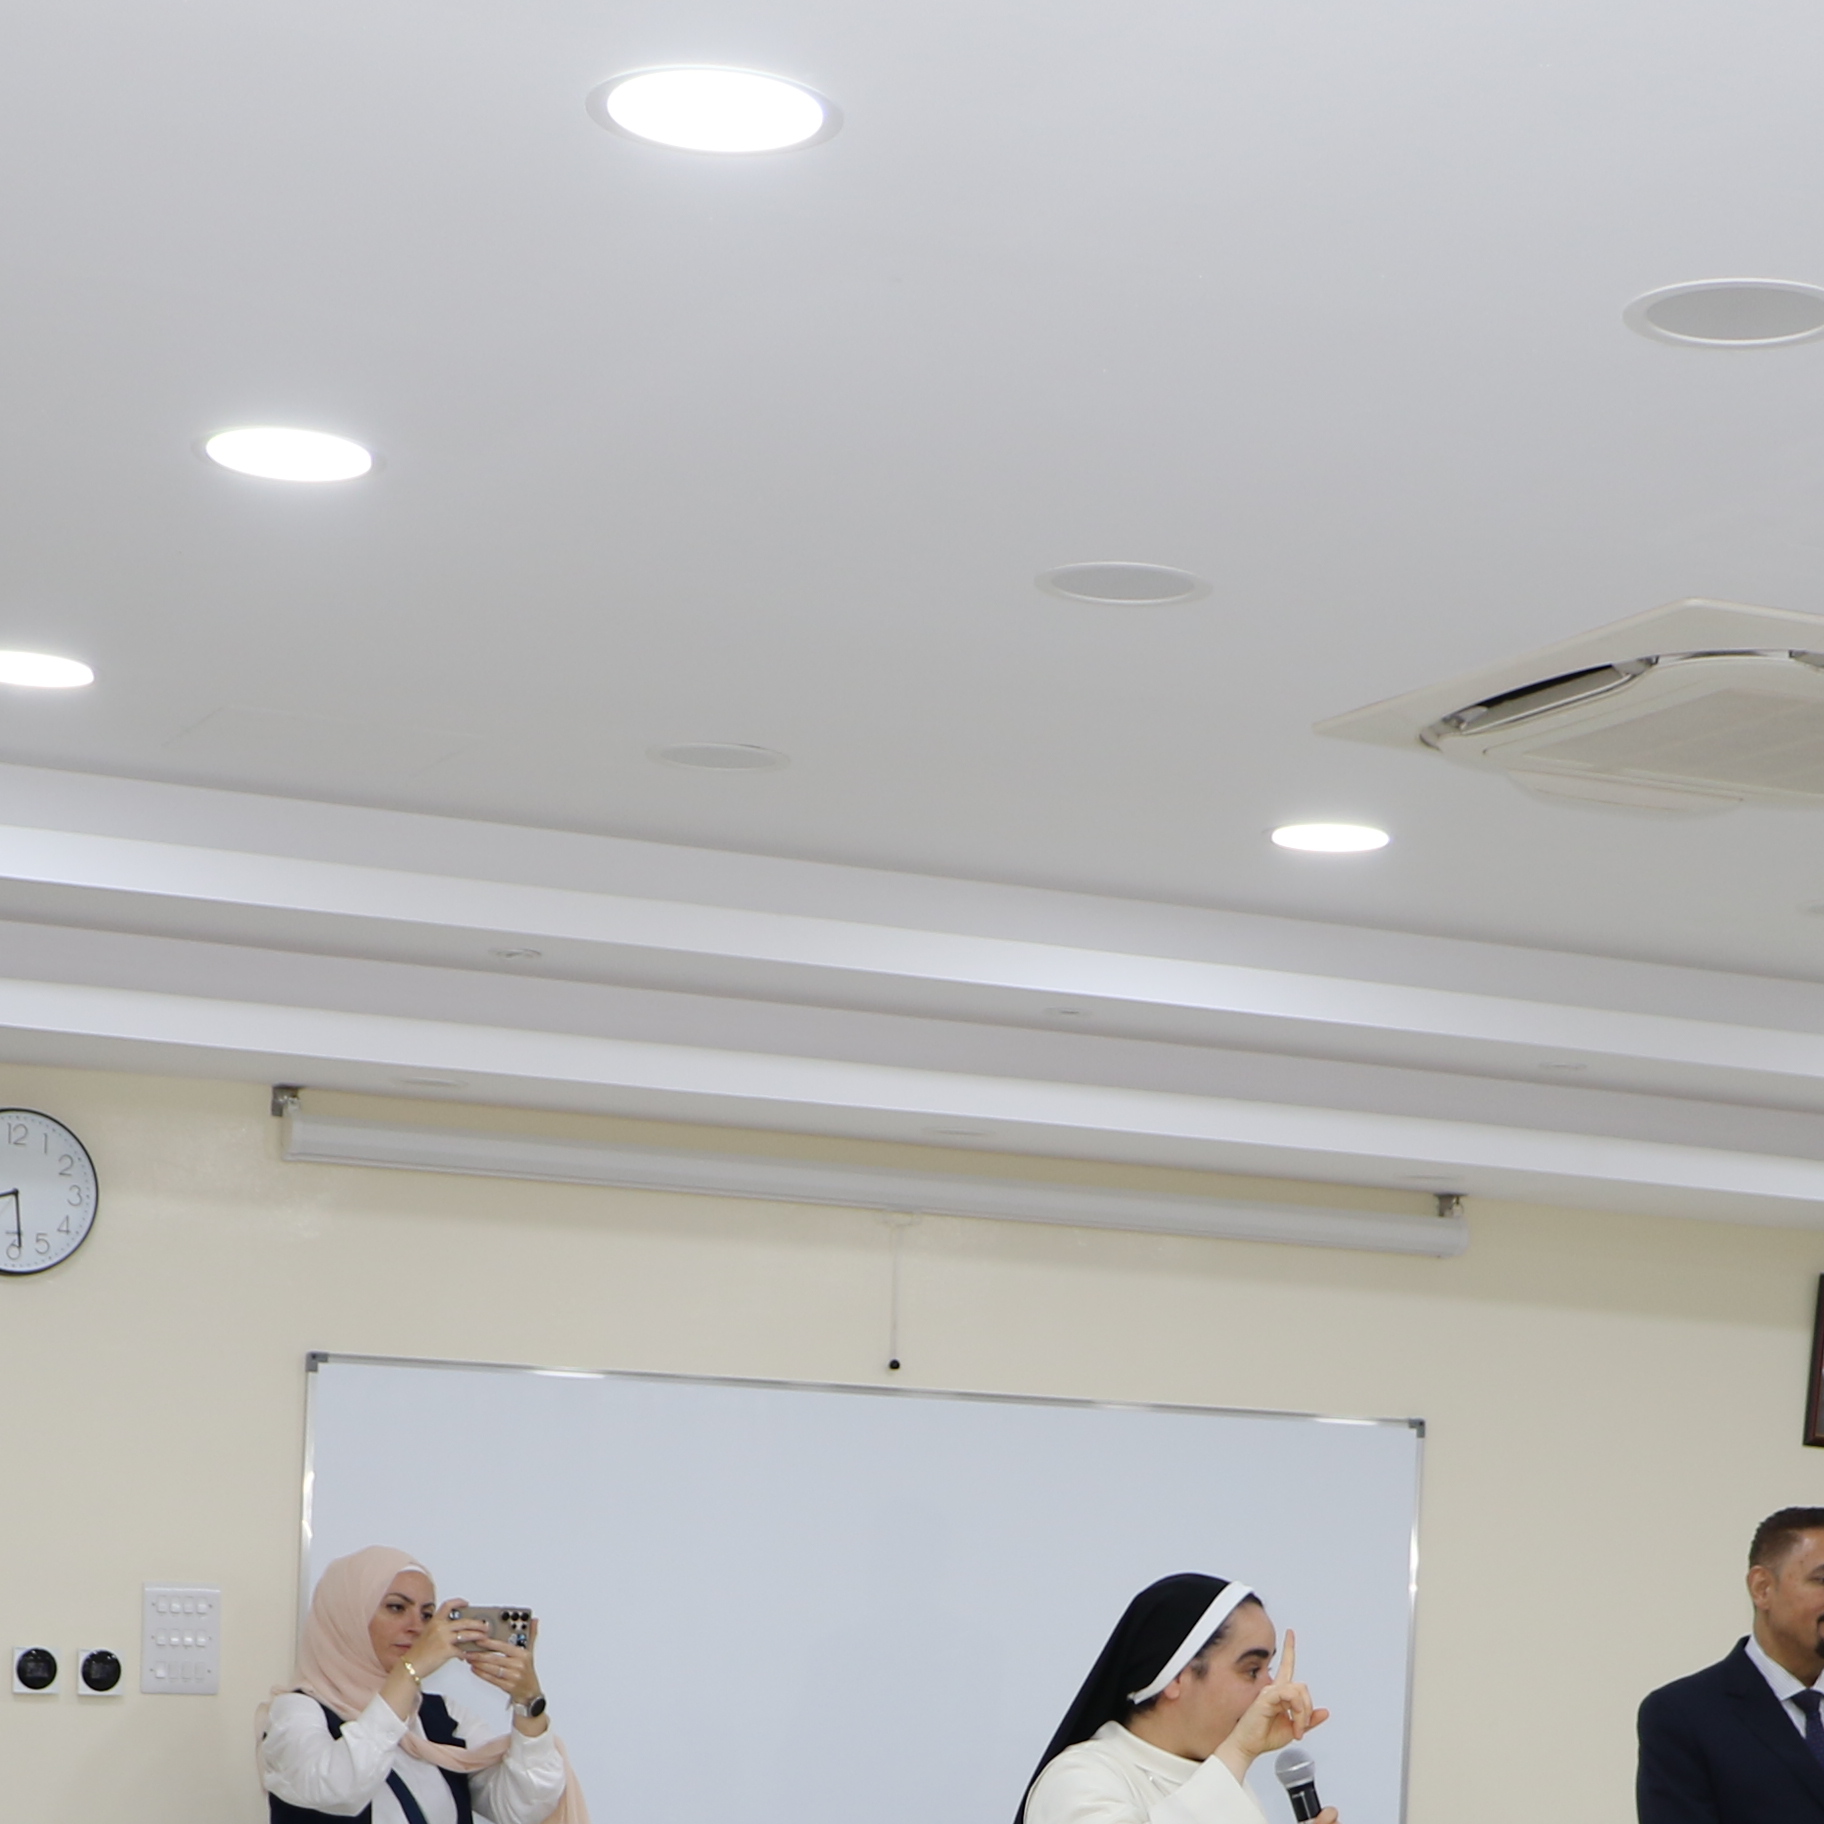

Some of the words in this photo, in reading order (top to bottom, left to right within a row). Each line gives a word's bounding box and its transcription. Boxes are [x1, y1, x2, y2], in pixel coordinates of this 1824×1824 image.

[7, 1122, 28, 1146] 12
[42, 1132, 49, 1155] 1
[58, 1154, 74, 1176] 2
[67, 1184, 82, 1207] 3
[57, 1214, 71, 1235] 4
[6, 1239, 22, 1261] 6
[35, 1232, 50, 1255] 5
